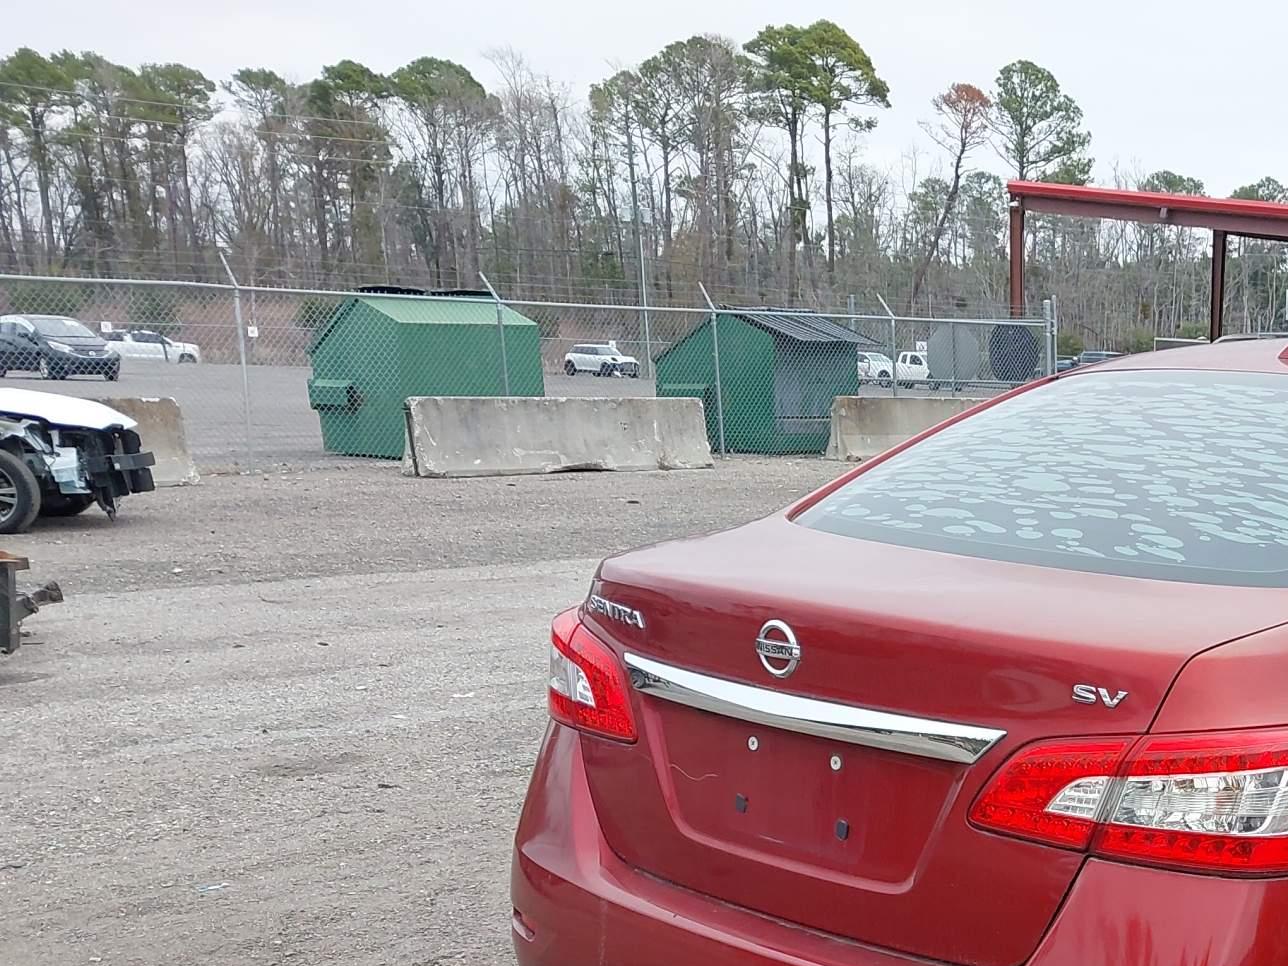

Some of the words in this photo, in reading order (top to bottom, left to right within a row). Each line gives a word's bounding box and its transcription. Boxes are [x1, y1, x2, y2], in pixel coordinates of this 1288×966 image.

[590, 594, 645, 629] SENTRA
[756, 641, 793, 656] NISSAN
[1071, 684, 1129, 708] SV
